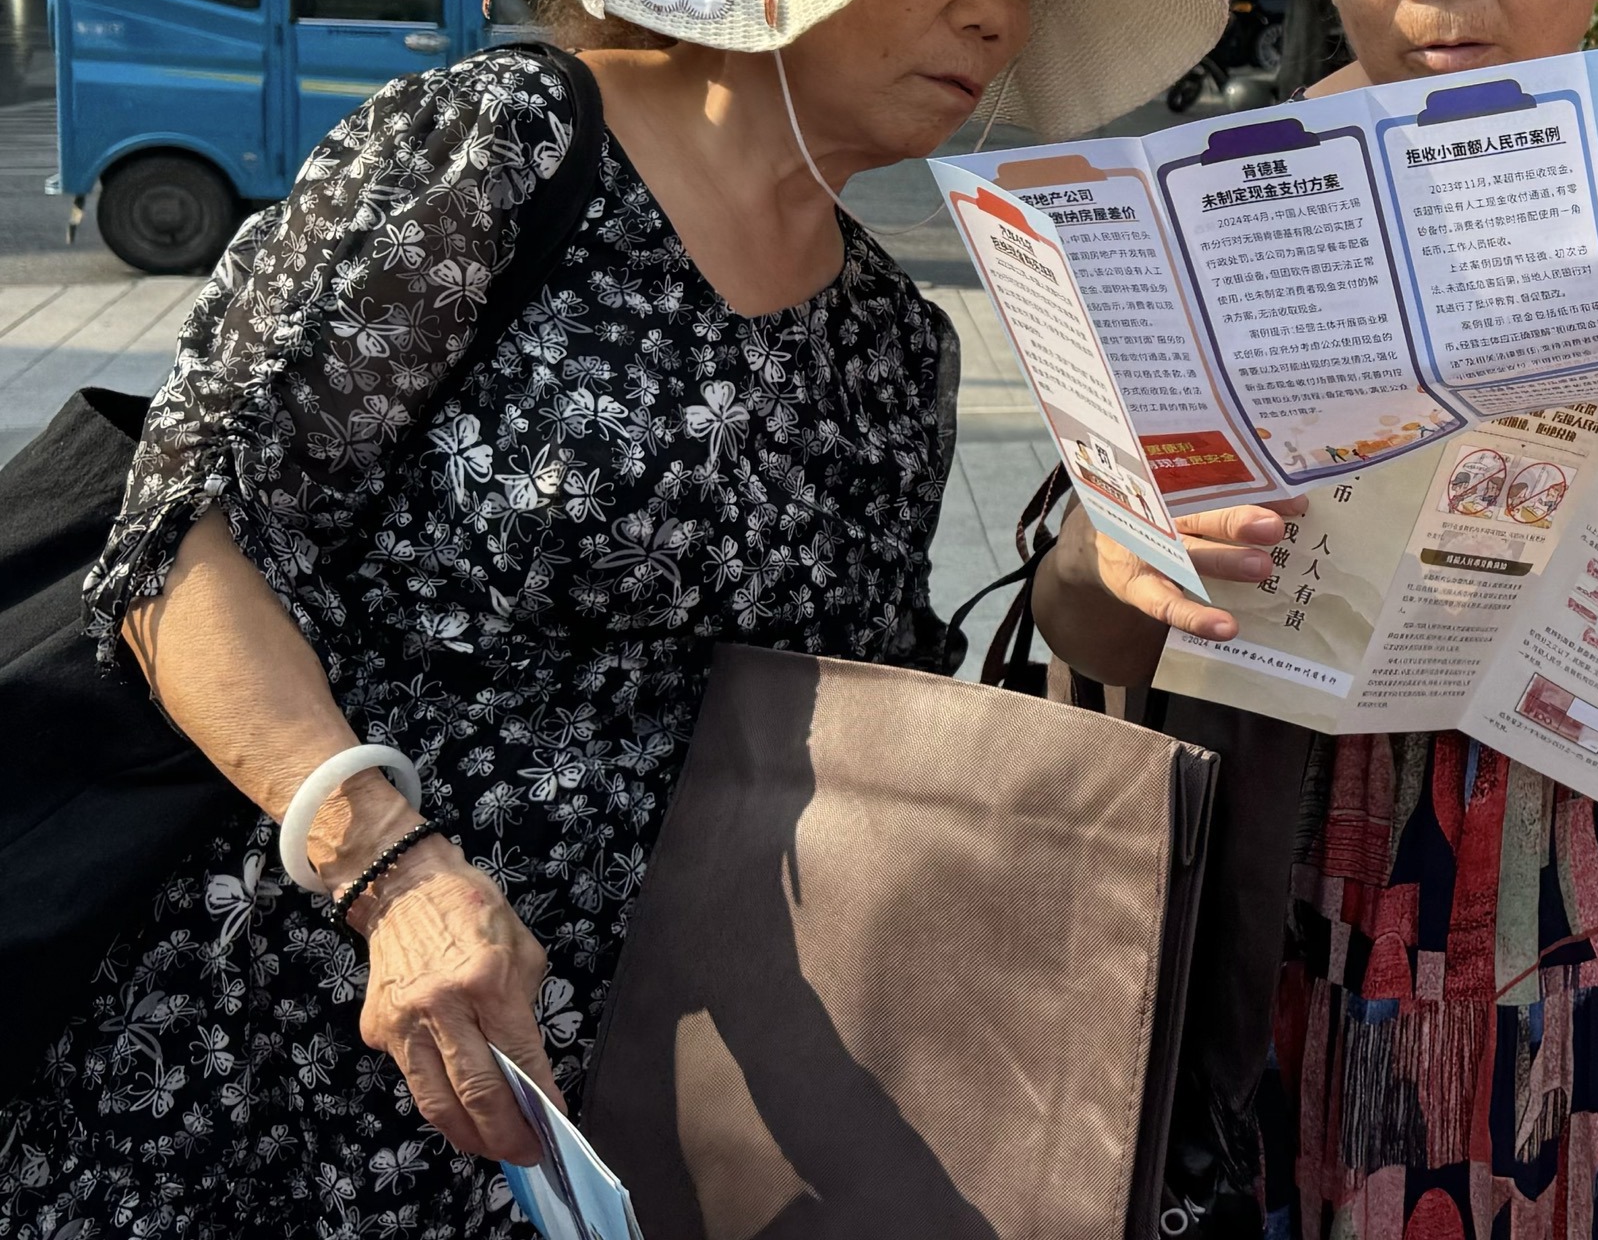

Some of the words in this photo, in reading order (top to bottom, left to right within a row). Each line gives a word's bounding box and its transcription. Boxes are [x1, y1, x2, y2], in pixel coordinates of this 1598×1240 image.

[1406, 126, 1561, 164] 拒收小面额人民币案例
[1242, 160, 1288, 178] 肯德基
[1202, 174, 1340, 209] 未制定现金支付方案
[1334, 484, 1353, 503] 币
[1283, 533, 1331, 631] 人人有责
